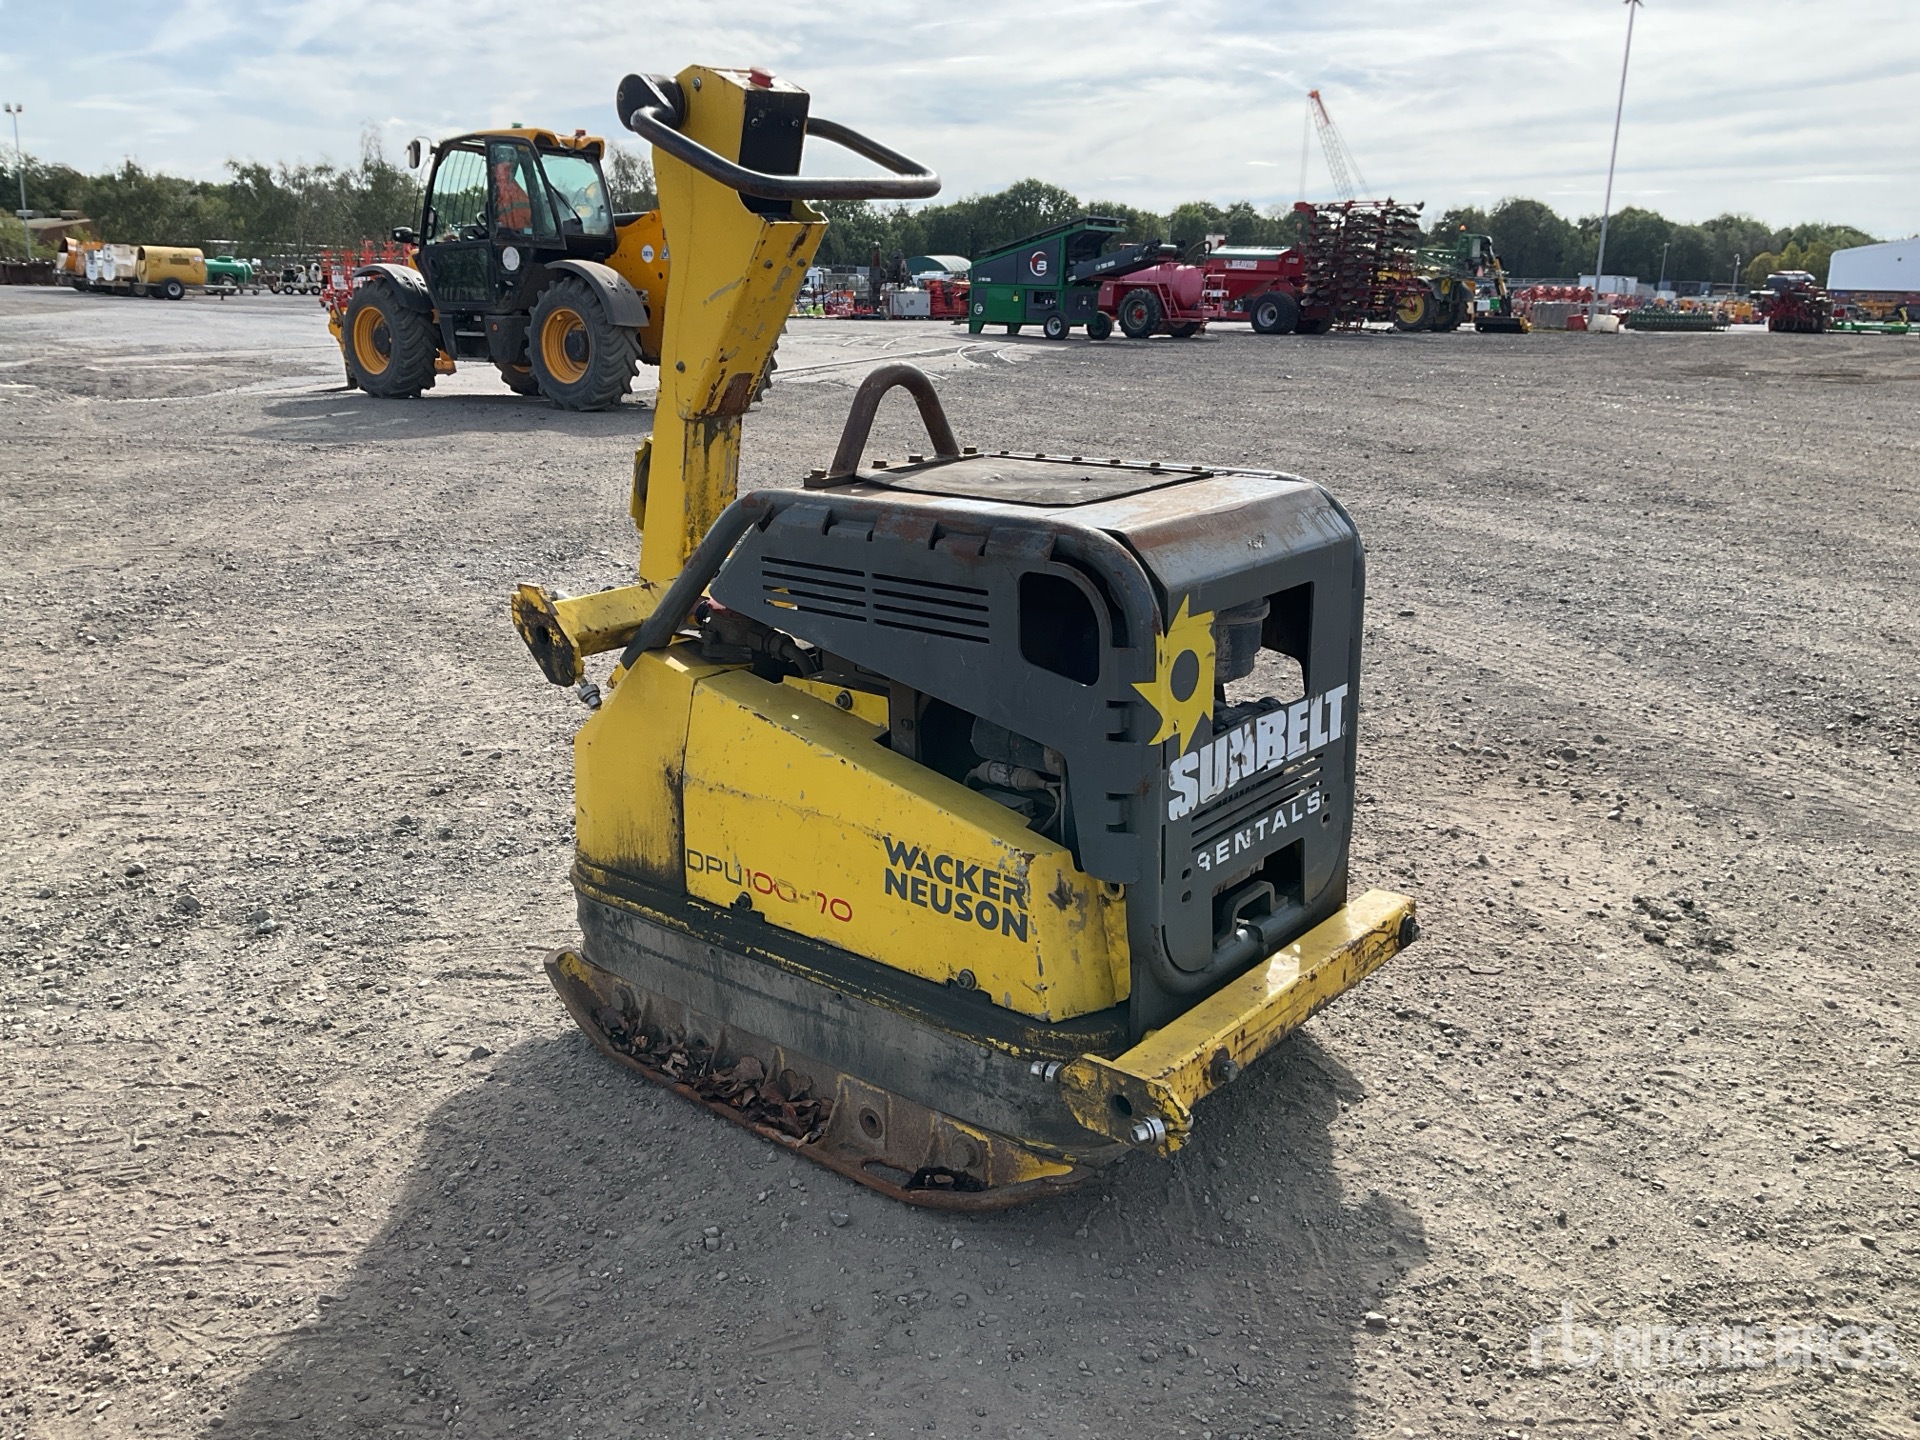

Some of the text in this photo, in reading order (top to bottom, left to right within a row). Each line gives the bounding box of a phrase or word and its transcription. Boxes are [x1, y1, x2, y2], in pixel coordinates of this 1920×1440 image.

[1169, 684, 1348, 821] SUNBELT
[1197, 790, 1321, 871] RENTALS
[884, 836, 1028, 909] WACKER
[884, 866, 1028, 942] NEUSON
